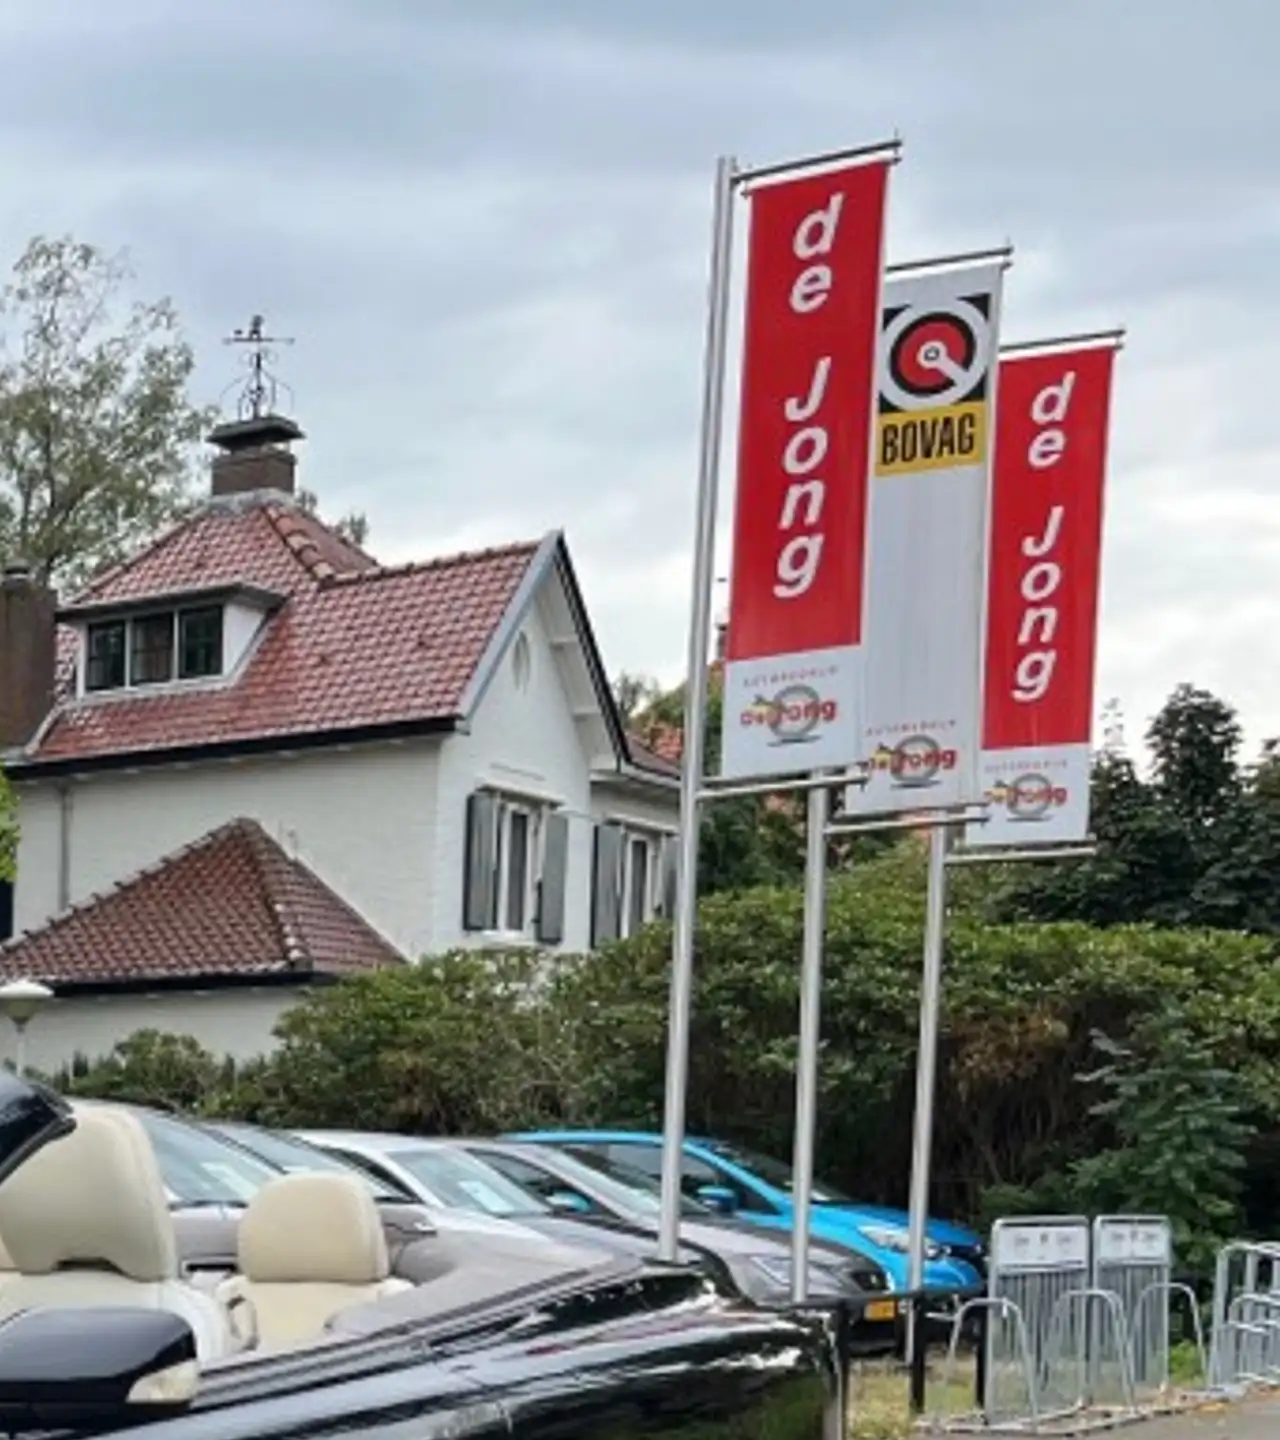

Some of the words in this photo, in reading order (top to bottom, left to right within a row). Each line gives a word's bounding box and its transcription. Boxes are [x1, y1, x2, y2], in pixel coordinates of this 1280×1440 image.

[789, 192, 844, 314] de
[773, 356, 831, 598] Jong
[881, 413, 975, 466] BOVAG
[1028, 371, 1075, 467] de
[1011, 505, 1065, 702] Jong
